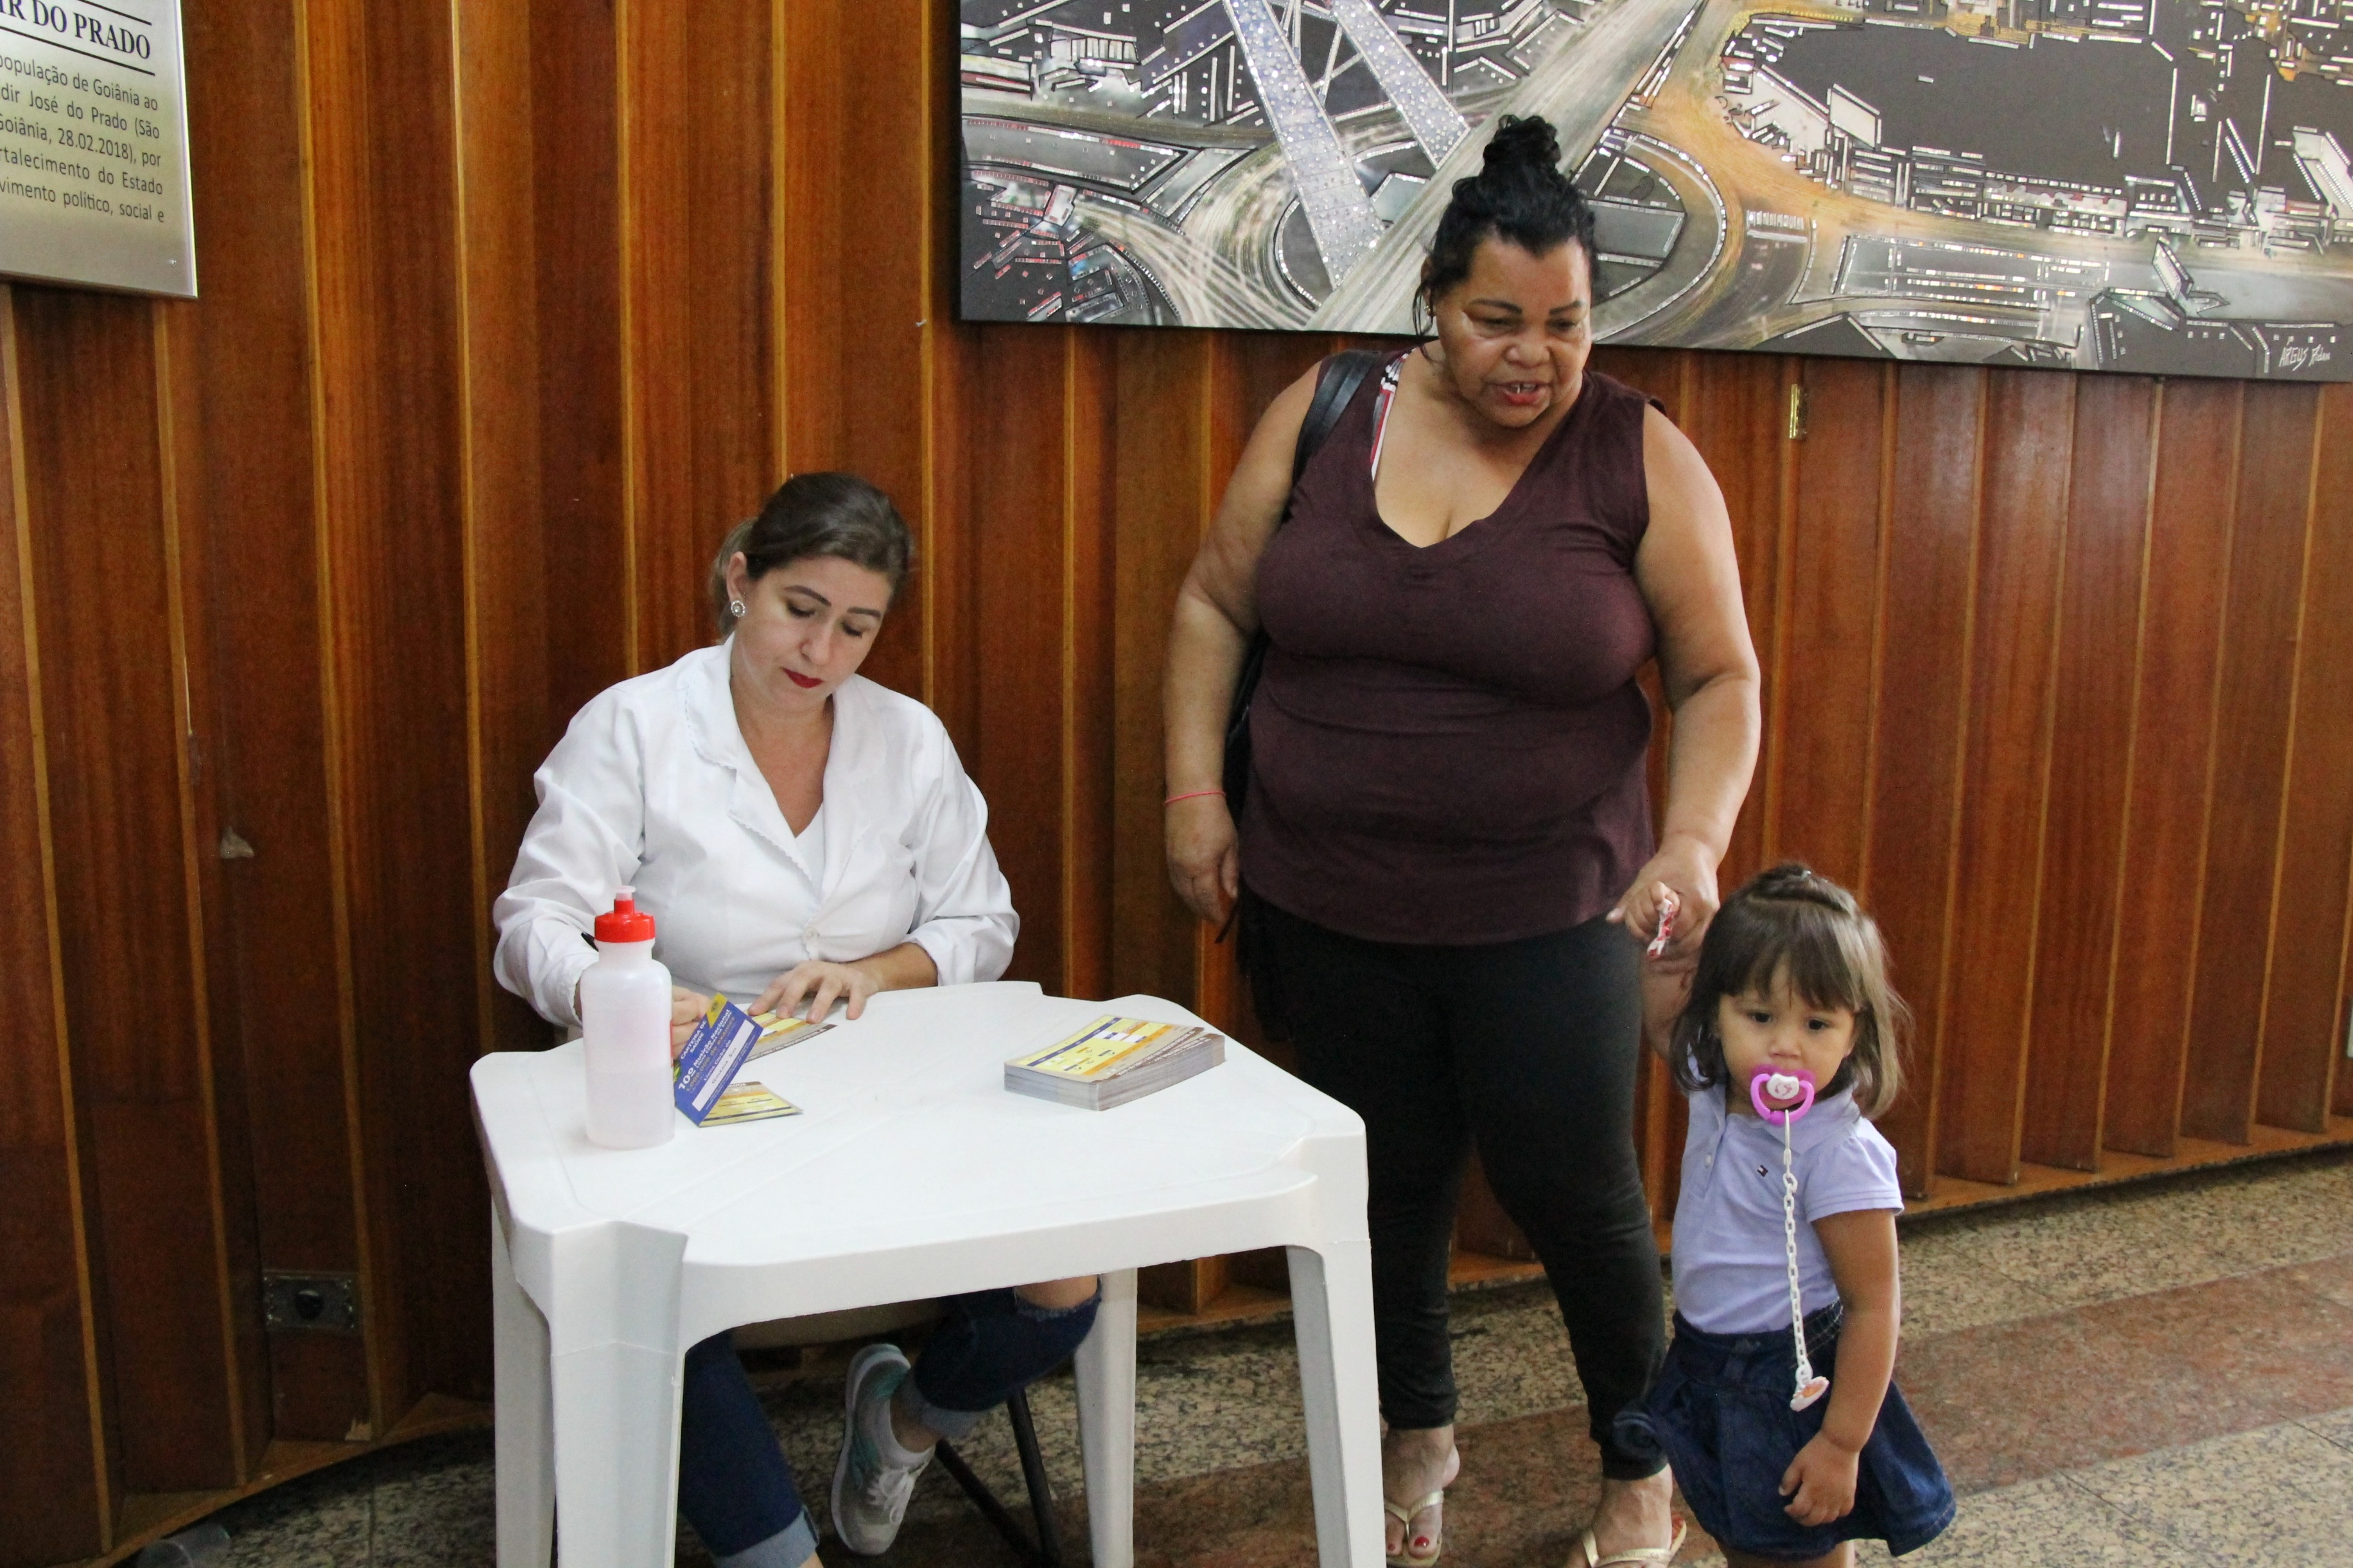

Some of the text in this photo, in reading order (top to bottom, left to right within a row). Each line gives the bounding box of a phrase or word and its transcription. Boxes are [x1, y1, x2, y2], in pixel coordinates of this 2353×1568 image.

[33, 0, 67, 33] DO
[73, 12, 151, 60] PRADO
[73, 72, 89, 92] de
[93, 78, 140, 106] Goiânia
[144, 96, 158, 111] ao
[29, 91, 58, 114] José
[67, 101, 83, 120] do
[91, 107, 127, 131] Prado
[135, 117, 160, 139] (São
[58, 128, 137, 164] 28.02.2018),
[142, 152, 161, 167] por
[98, 167, 114, 185] do
[122, 172, 163, 195] Estado
[63, 191, 113, 216] político,
[119, 203, 152, 220] social
[157, 211, 165, 222] e
[678, 1067, 696, 1090] 10º
[693, 1039, 712, 1067] Mutirão
[710, 1009, 730, 1039] Nacional
[681, 1021, 707, 1060] CARTEIRA DE
[690, 1032, 704, 1053] SAÚDE
[703, 1039, 732, 1081] Lions Clube de
